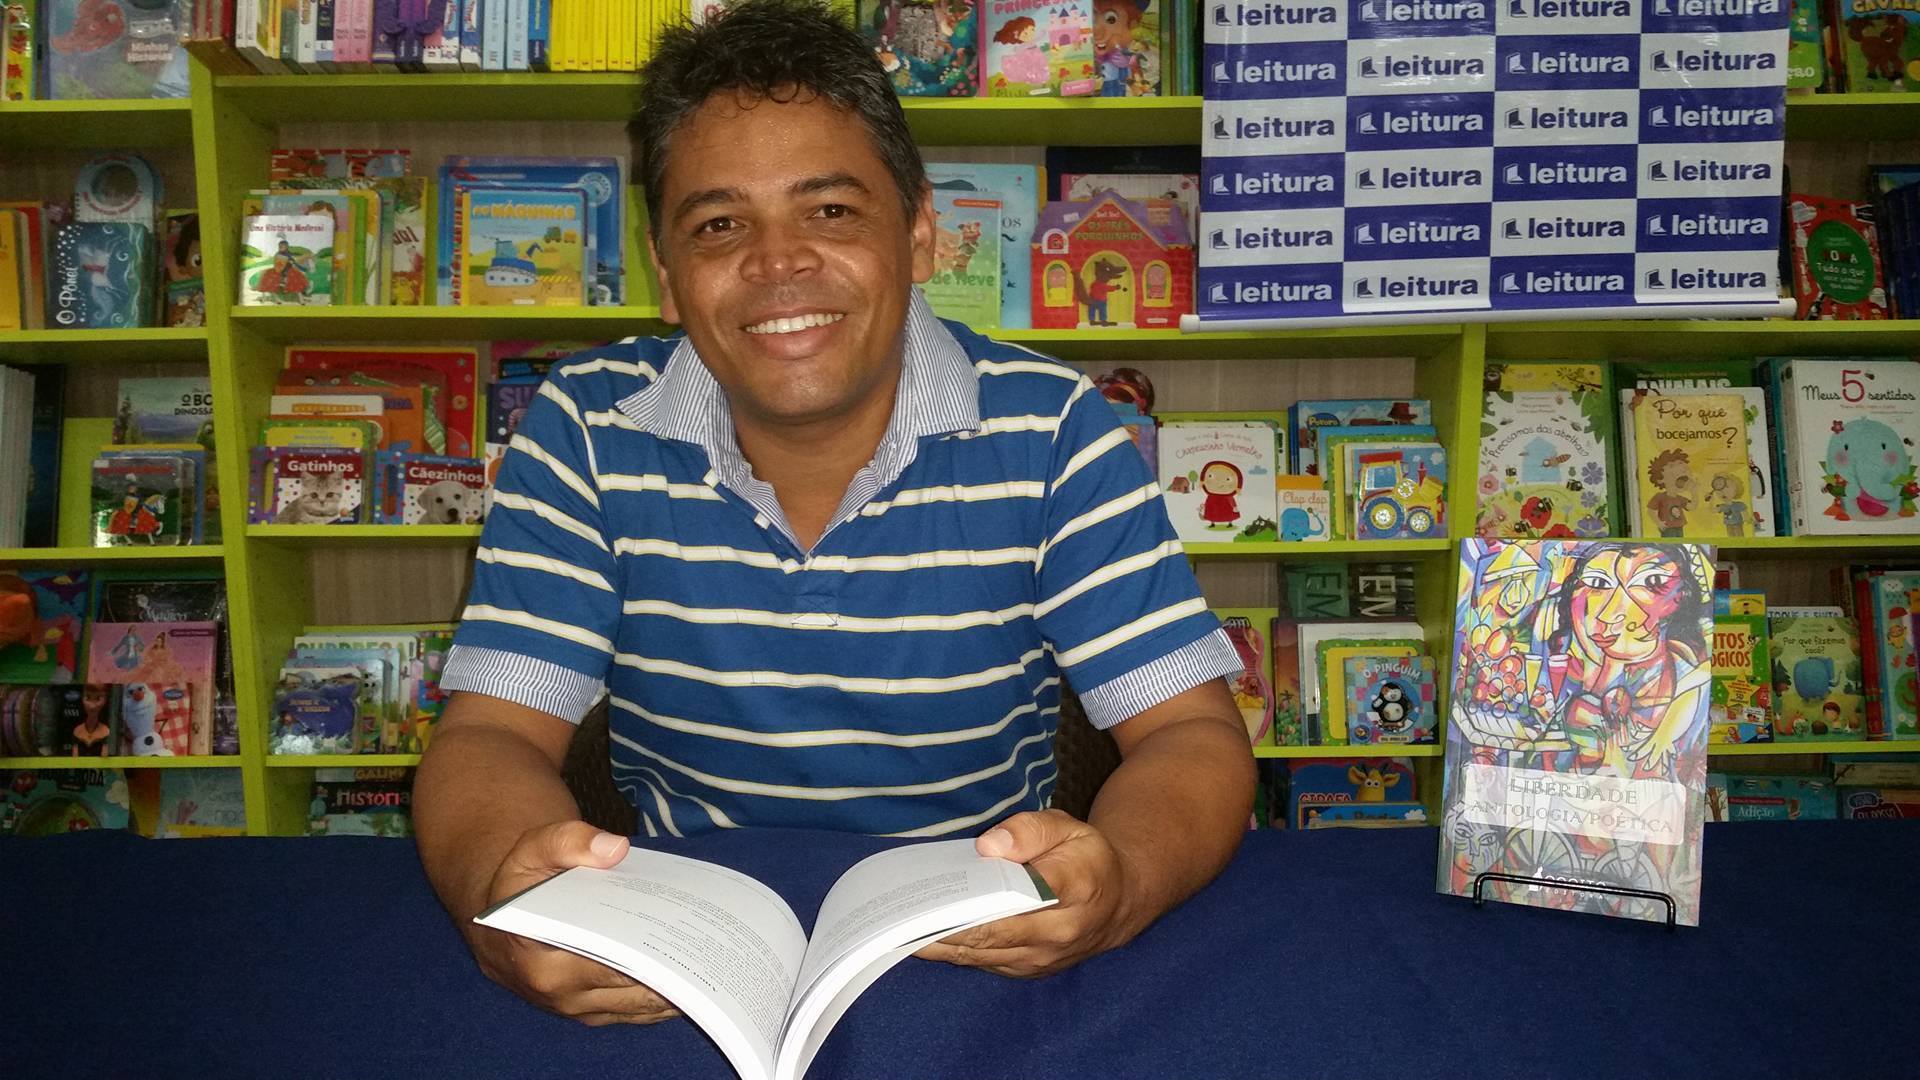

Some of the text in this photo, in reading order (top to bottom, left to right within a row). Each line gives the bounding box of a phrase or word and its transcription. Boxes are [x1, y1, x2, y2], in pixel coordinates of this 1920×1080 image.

[1237, 4, 1337, 26] leitura
[1385, 0, 1486, 21] leitura
[1533, 0, 1631, 18] leitura
[1678, 0, 1780, 16] leitura
[1236, 60, 1336, 83] leitura
[1385, 55, 1484, 77] leitura
[1532, 52, 1630, 74] leitura
[1677, 50, 1776, 72] leitura
[1383, 111, 1483, 133] leitura
[1531, 107, 1628, 129] leitura
[1675, 105, 1774, 127] leitura
[1236, 117, 1335, 139] leitura
[1383, 167, 1482, 188] leitura
[1530, 163, 1627, 184] leitura
[1674, 160, 1771, 181] leitura
[1235, 173, 1334, 194] leitura
[1381, 221, 1480, 244] leitura
[1529, 217, 1626, 239] leitura
[1672, 214, 1769, 236] leitura
[1235, 227, 1333, 249] leitura
[1380, 276, 1478, 297] leitura
[1527, 271, 1624, 293] leitura
[1672, 268, 1766, 289] leitura
[1234, 281, 1332, 303] leitura
[1801, 369, 1916, 402] Meus 5 sentidos
[1652, 399, 1693, 419] Por
[1536, 424, 1553, 434] das
[287, 459, 354, 473] Gatinhos
[409, 466, 483, 484] Cãezinhos
[1374, 662, 1420, 681] PINGUIM
[1510, 778, 1638, 804] LIBERDADE
[1471, 800, 1674, 834] ANTOLOGIA POÉTICA
[1737, 805, 1775, 819] Adição
